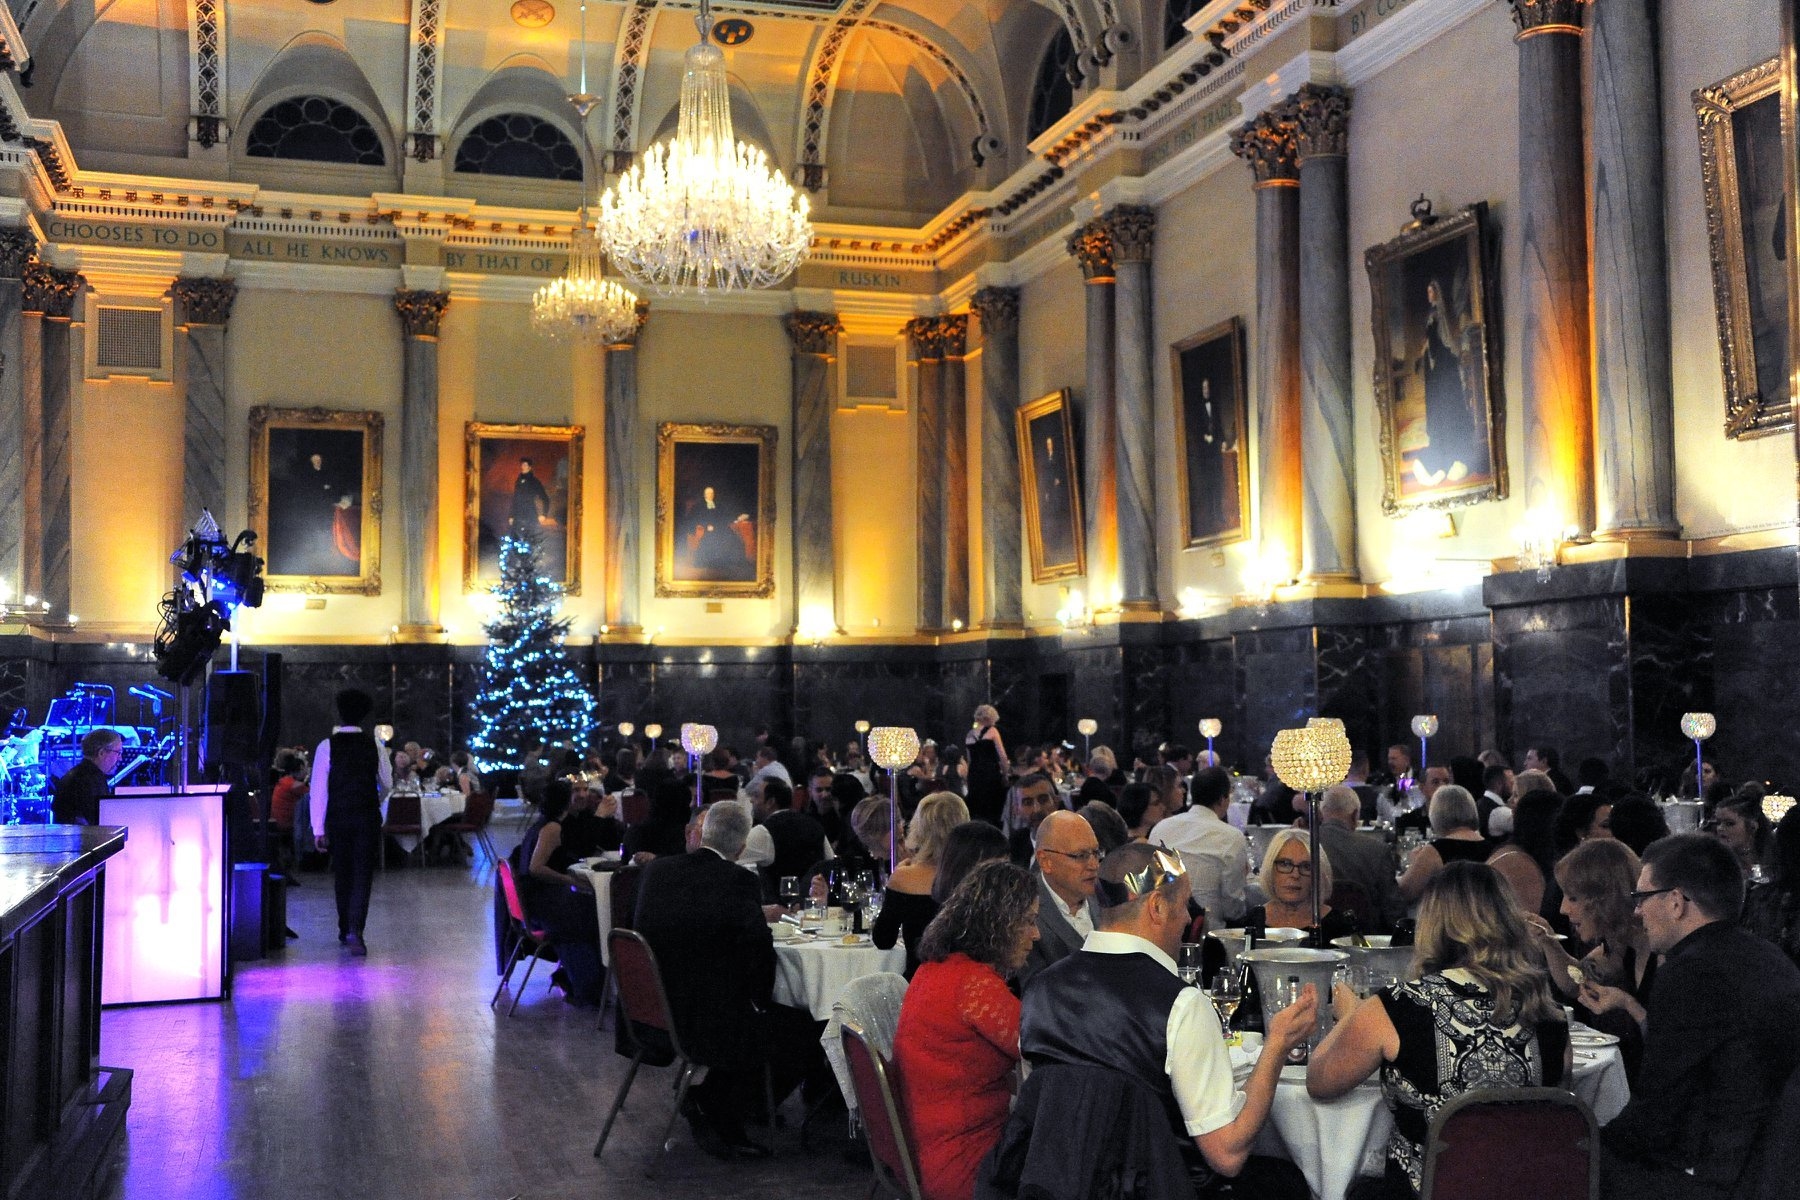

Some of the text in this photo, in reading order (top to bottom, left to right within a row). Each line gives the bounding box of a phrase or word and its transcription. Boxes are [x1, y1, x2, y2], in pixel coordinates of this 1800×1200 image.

[50, 221, 218, 247] CHOOSES TO DO
[242, 241, 389, 262] ALL HE KNOWS
[446, 252, 466, 267] BY
[476, 253, 521, 270] THAT
[531, 256, 554, 272] OF
[840, 271, 900, 287] RUSKIN
